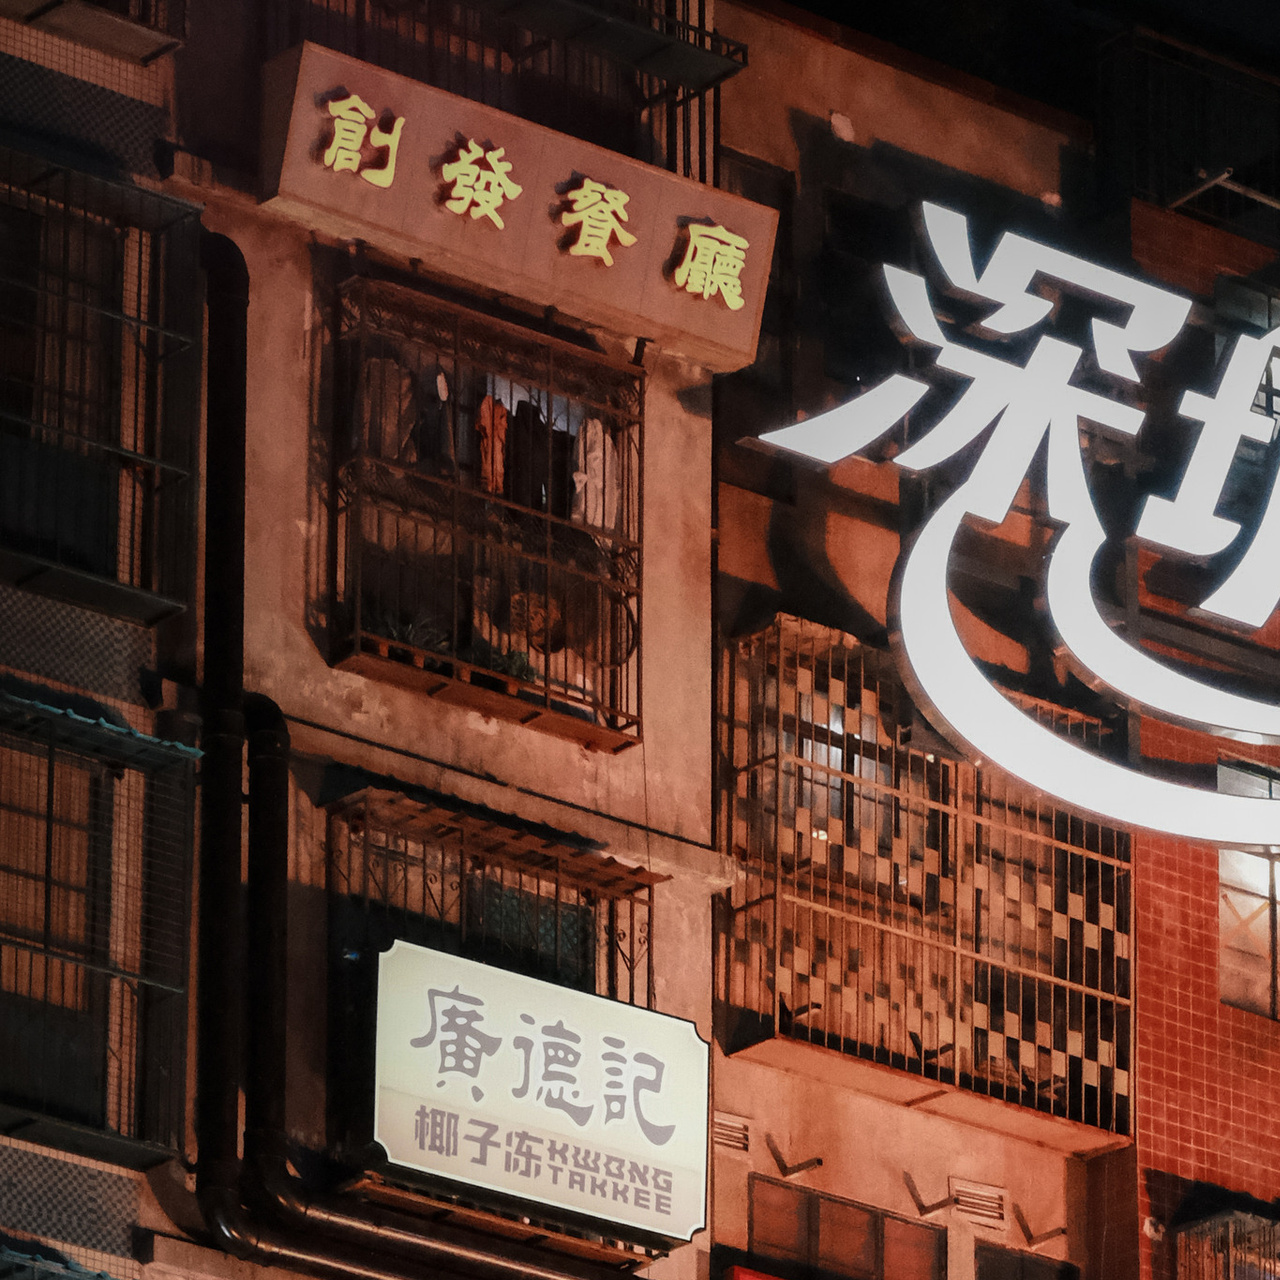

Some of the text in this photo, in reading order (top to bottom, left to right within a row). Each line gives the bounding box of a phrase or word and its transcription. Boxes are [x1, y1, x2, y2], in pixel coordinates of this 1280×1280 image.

[323, 94, 750, 310] 創發餐廳
[548, 1138, 673, 1194] KWONG
